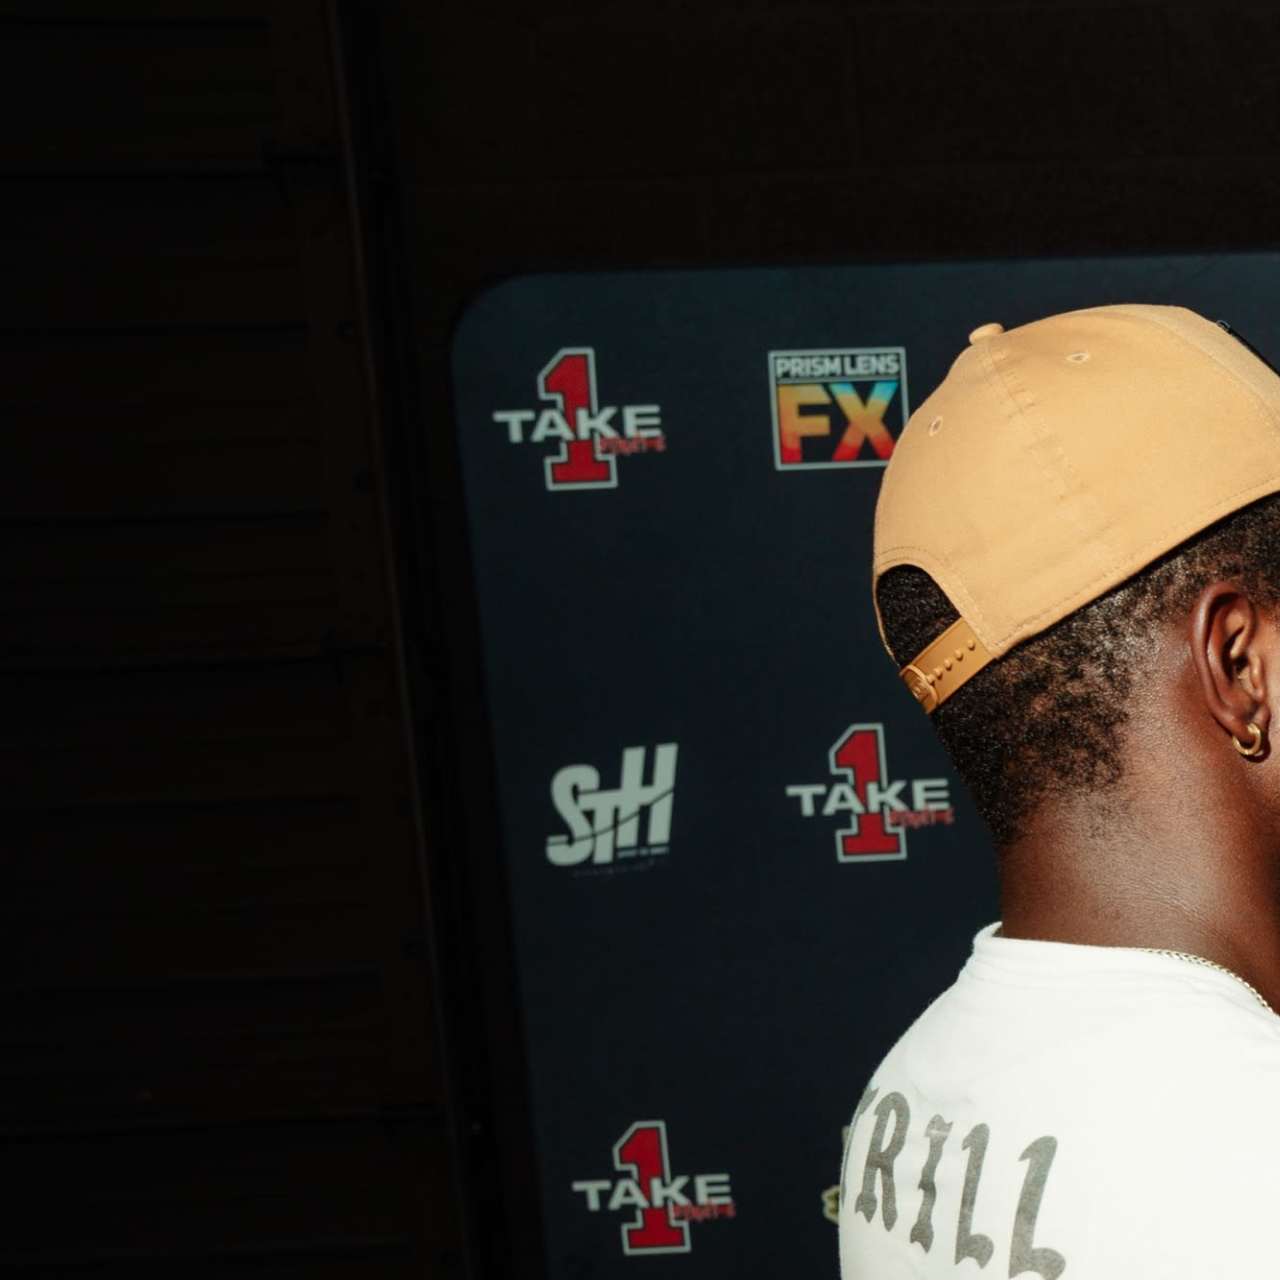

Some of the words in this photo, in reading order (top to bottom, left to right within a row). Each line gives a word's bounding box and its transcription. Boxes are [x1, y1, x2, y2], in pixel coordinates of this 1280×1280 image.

[776, 357, 841, 378] PRISM
[843, 354, 900, 376] LENS
[492, 404, 662, 443] TAKE
[778, 381, 898, 464] FX
[785, 778, 950, 817] TAKE
[571, 1173, 733, 1212] TAKE
